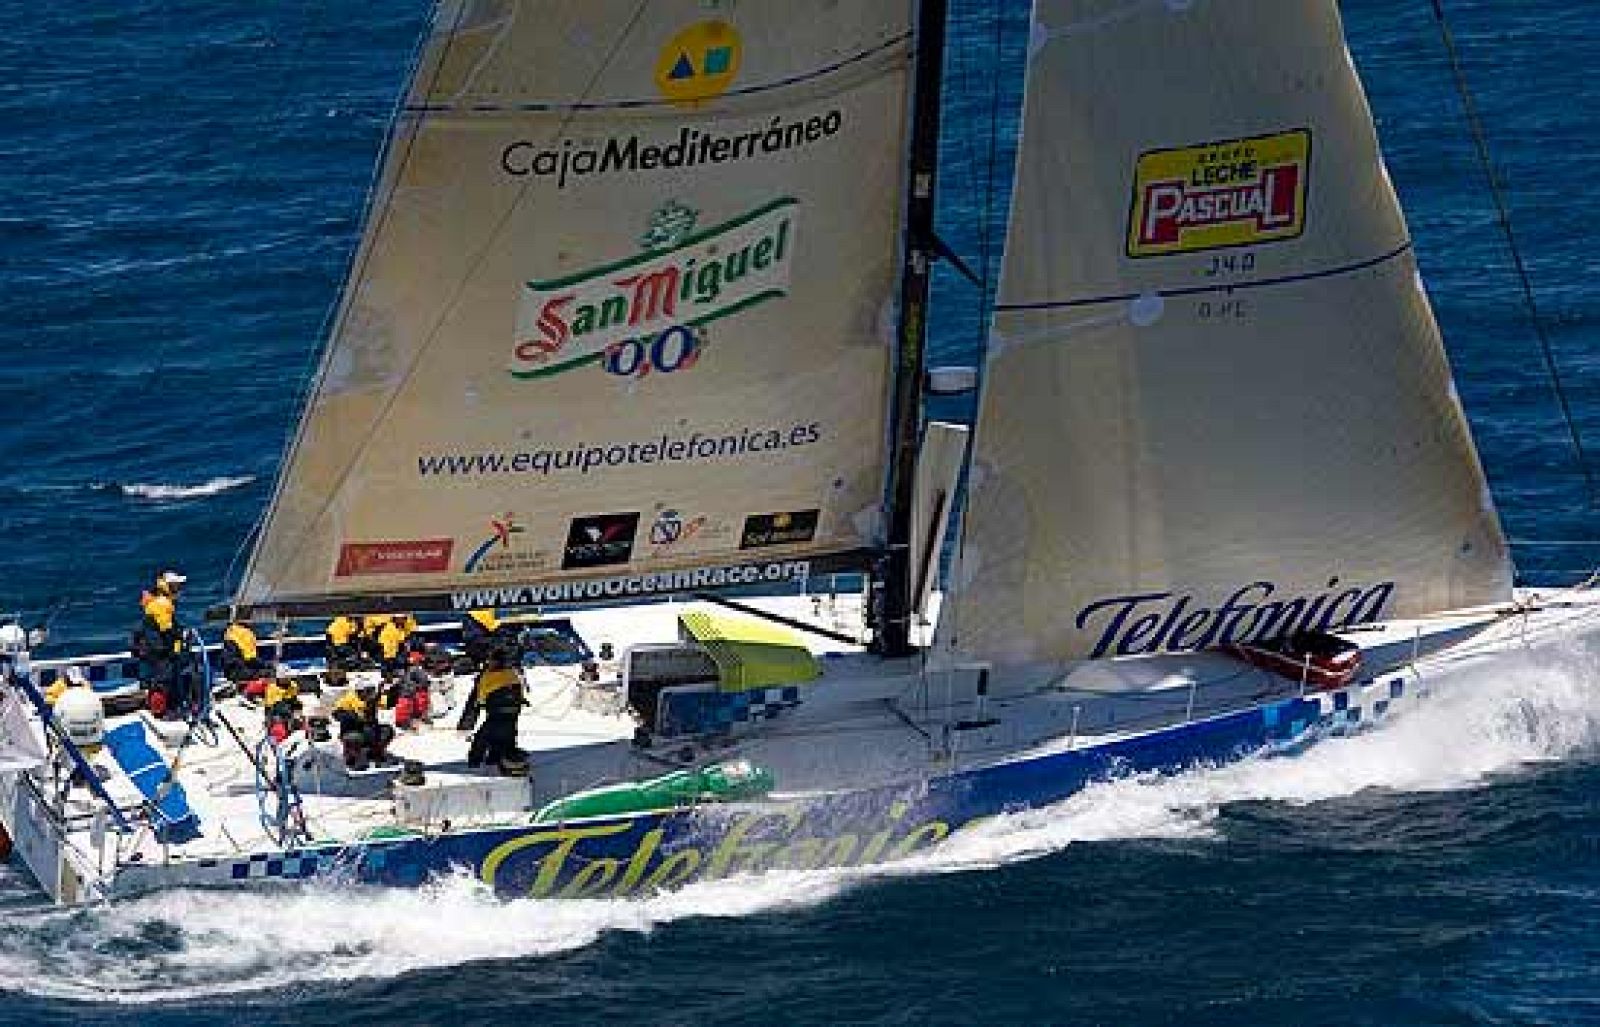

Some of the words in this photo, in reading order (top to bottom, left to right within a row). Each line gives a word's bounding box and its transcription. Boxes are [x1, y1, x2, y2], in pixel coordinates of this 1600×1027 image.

[502, 109, 842, 188] CajaMediterráneo
[1192, 159, 1257, 187] LECHE
[418, 421, 822, 475] www.equipotelefonica.es
